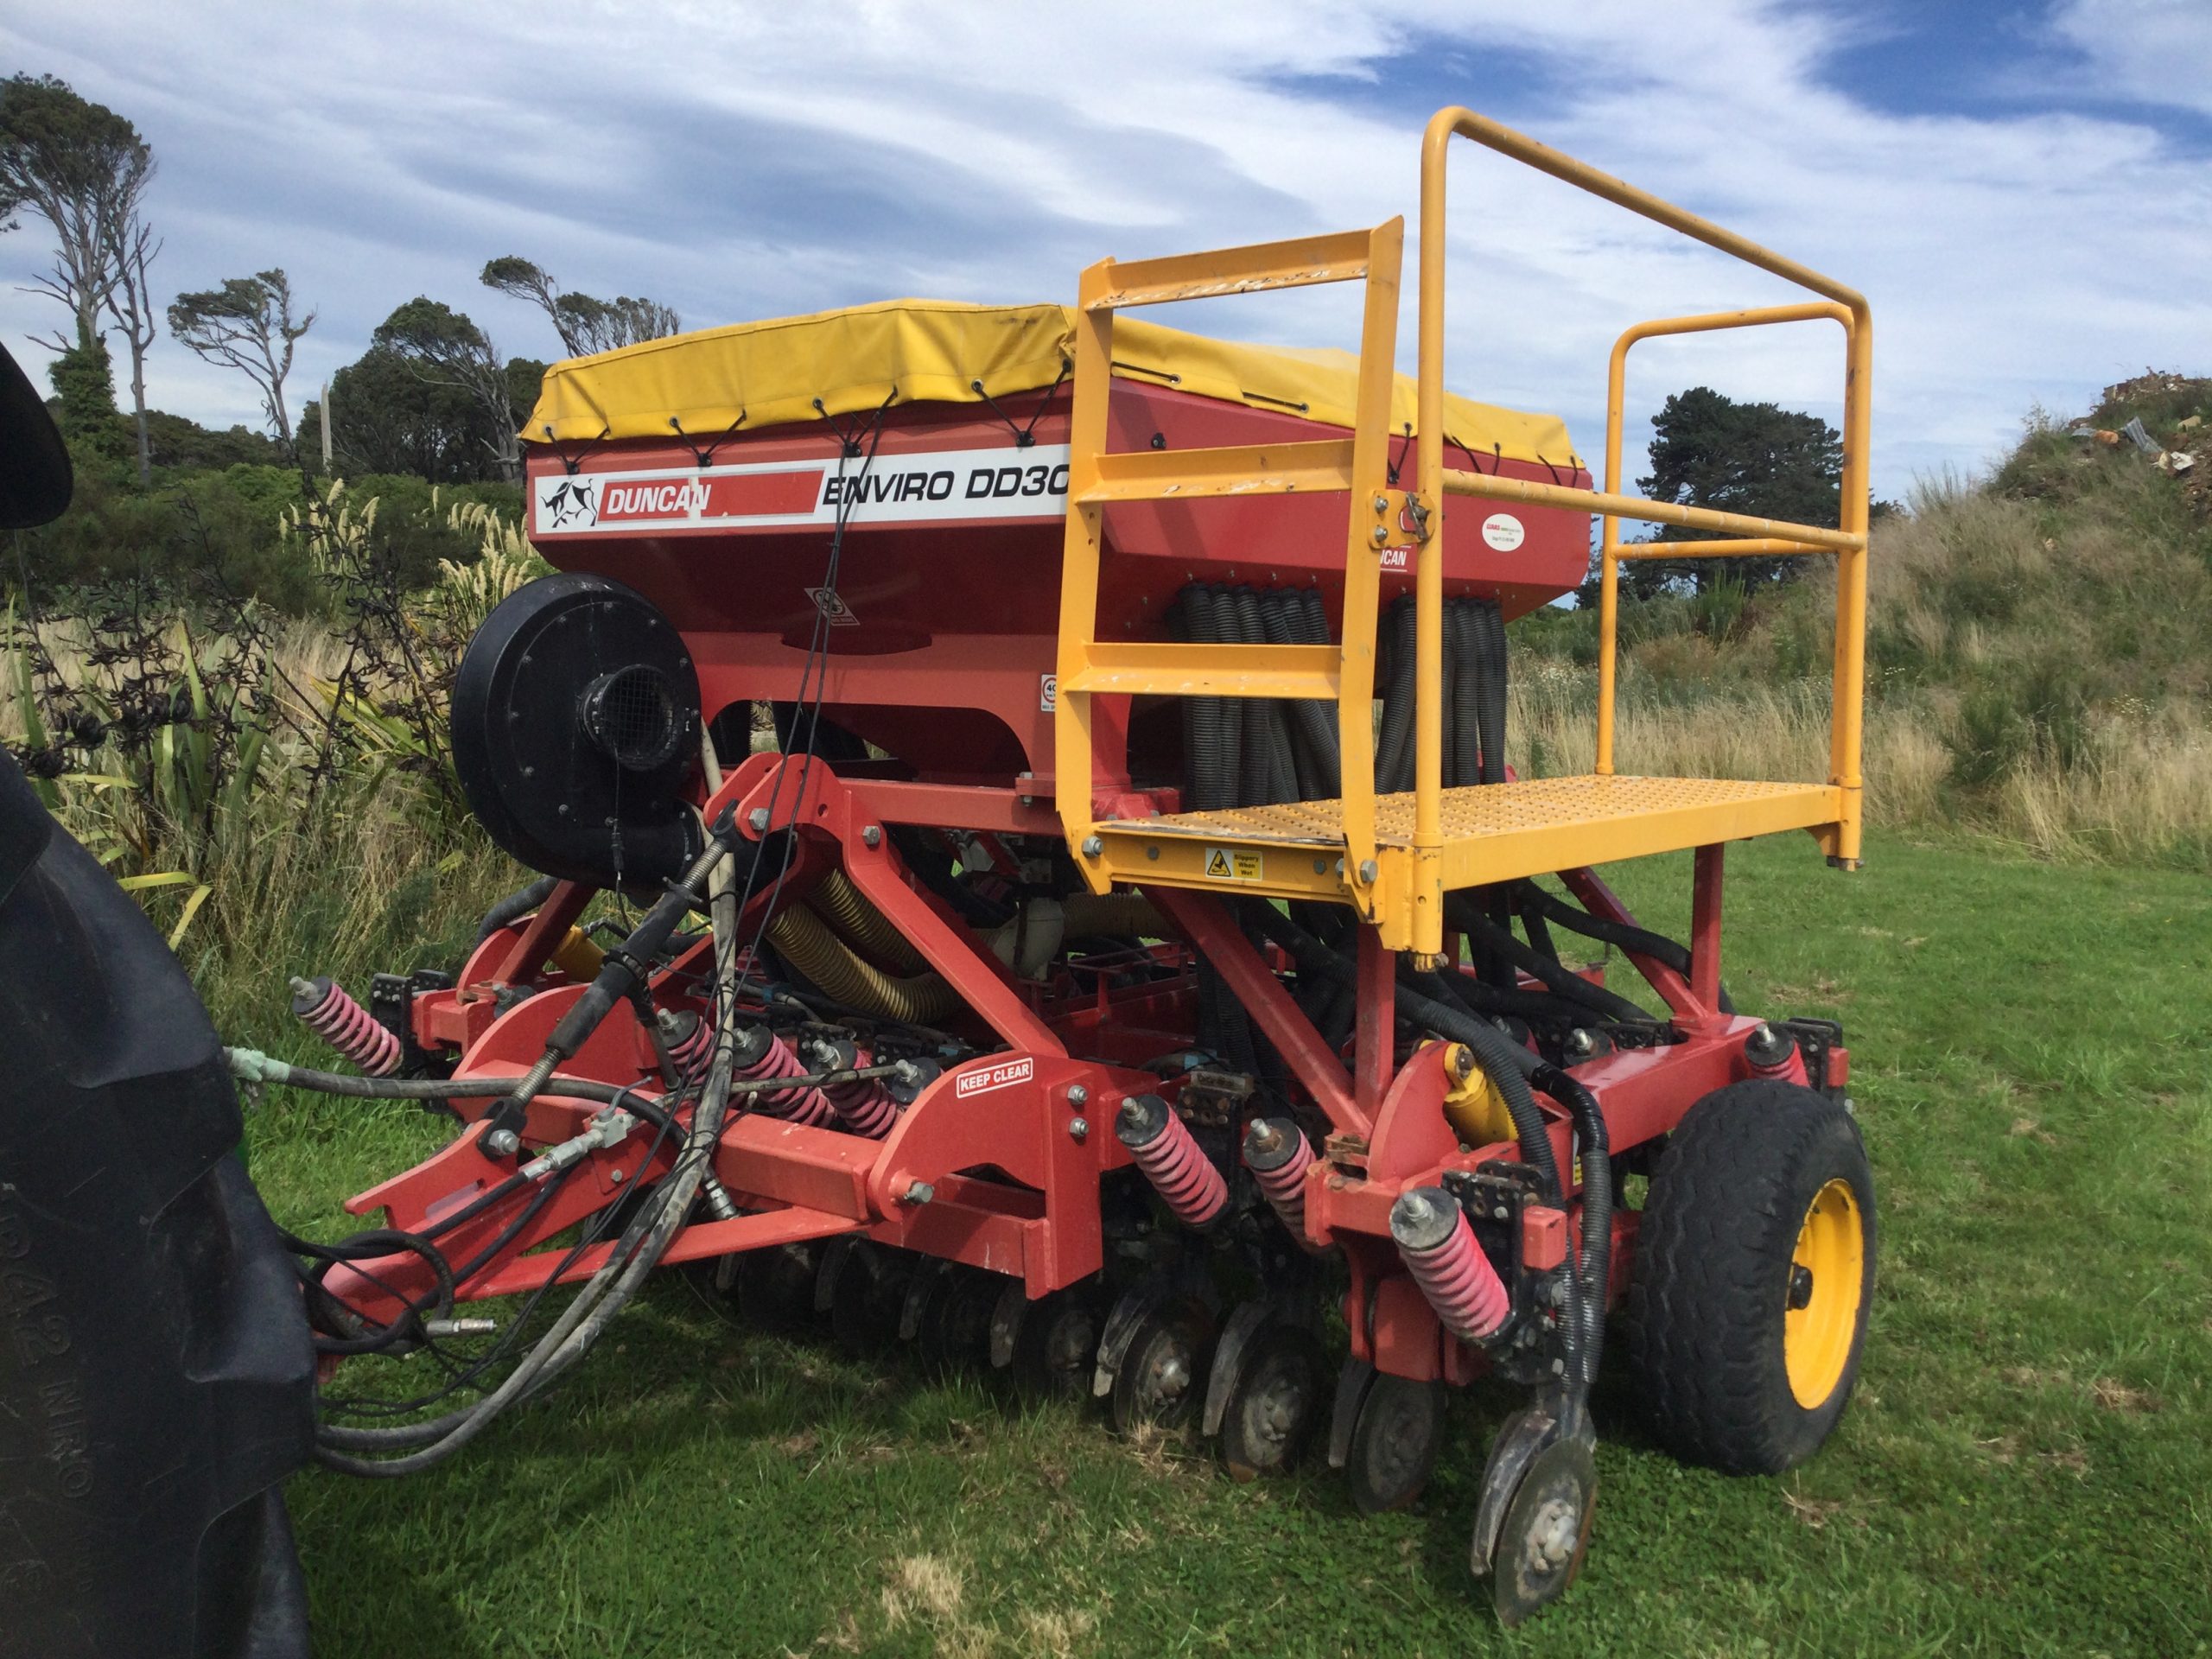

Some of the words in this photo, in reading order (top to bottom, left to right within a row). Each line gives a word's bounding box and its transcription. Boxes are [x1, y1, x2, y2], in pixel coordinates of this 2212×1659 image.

[607, 484, 712, 514] DUNCAN
[823, 471, 955, 505] ENVIRO
[965, 464, 1069, 499] DD30
[961, 1072, 991, 1091] KEEP
[993, 1064, 1029, 1083] CLEAR
